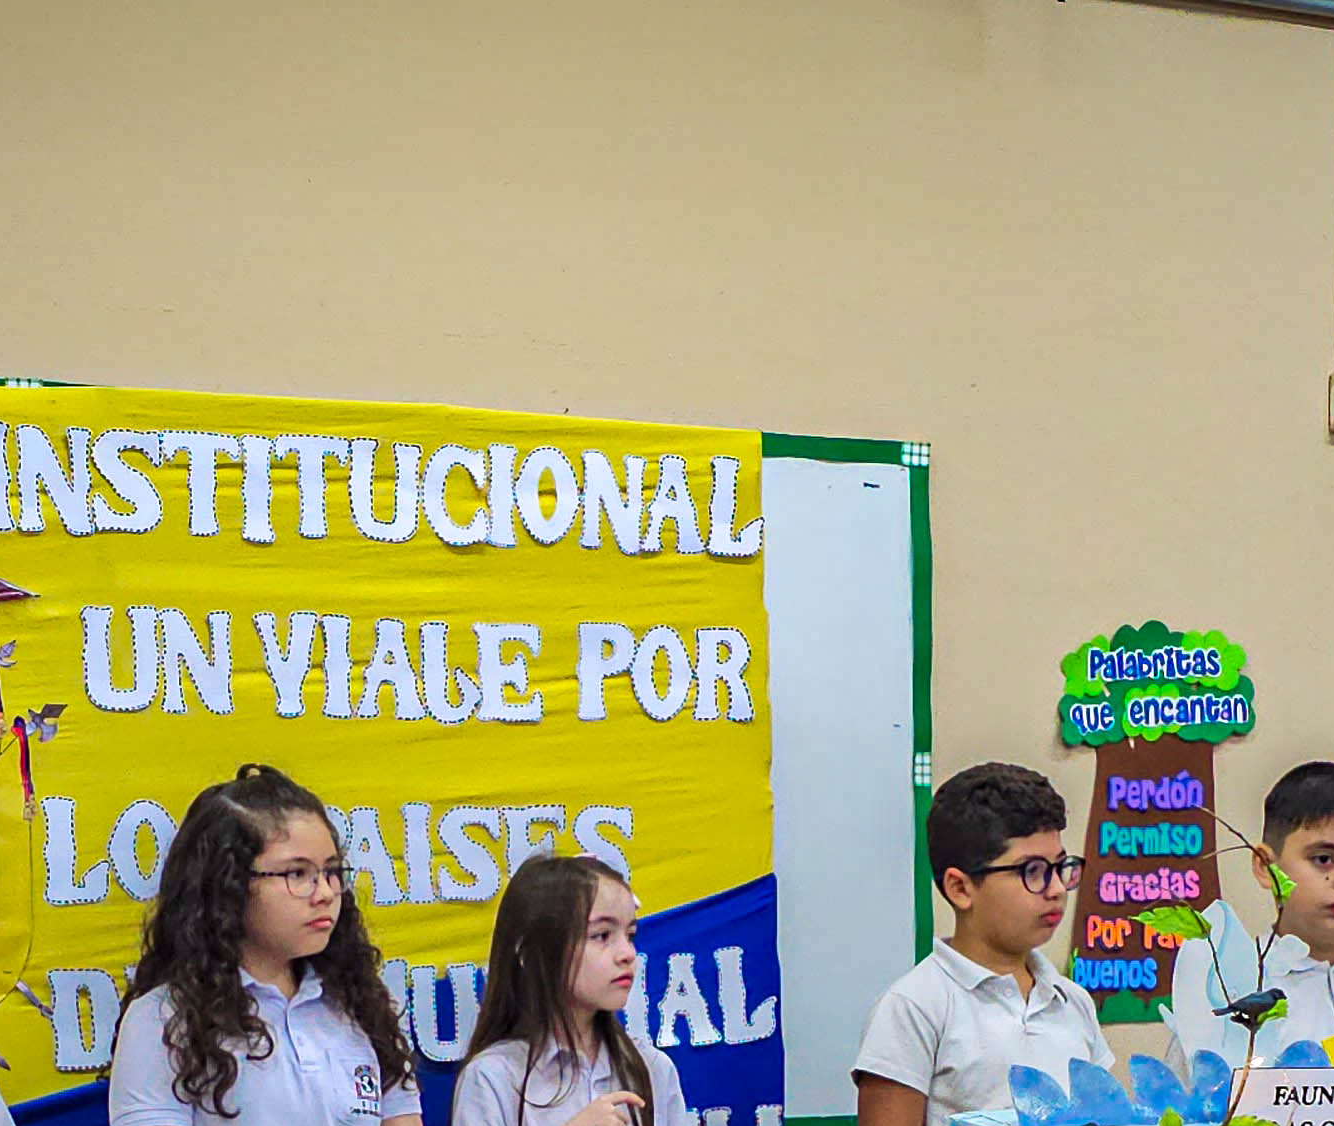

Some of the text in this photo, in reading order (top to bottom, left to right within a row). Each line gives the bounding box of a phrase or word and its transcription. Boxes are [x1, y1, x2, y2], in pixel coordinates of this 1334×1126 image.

[80, 604, 235, 717] UN
[576, 620, 755, 725] POR
[1088, 648, 1221, 682] Palabritas
[1071, 694, 1249, 734] que encantan
[1107, 768, 1204, 812] Perdón
[40, 794, 179, 906] LO
[1099, 821, 1203, 858] Permiso
[1099, 867, 1201, 903] Gracias
[1086, 914, 1132, 949] Por
[47, 967, 129, 1072] D
